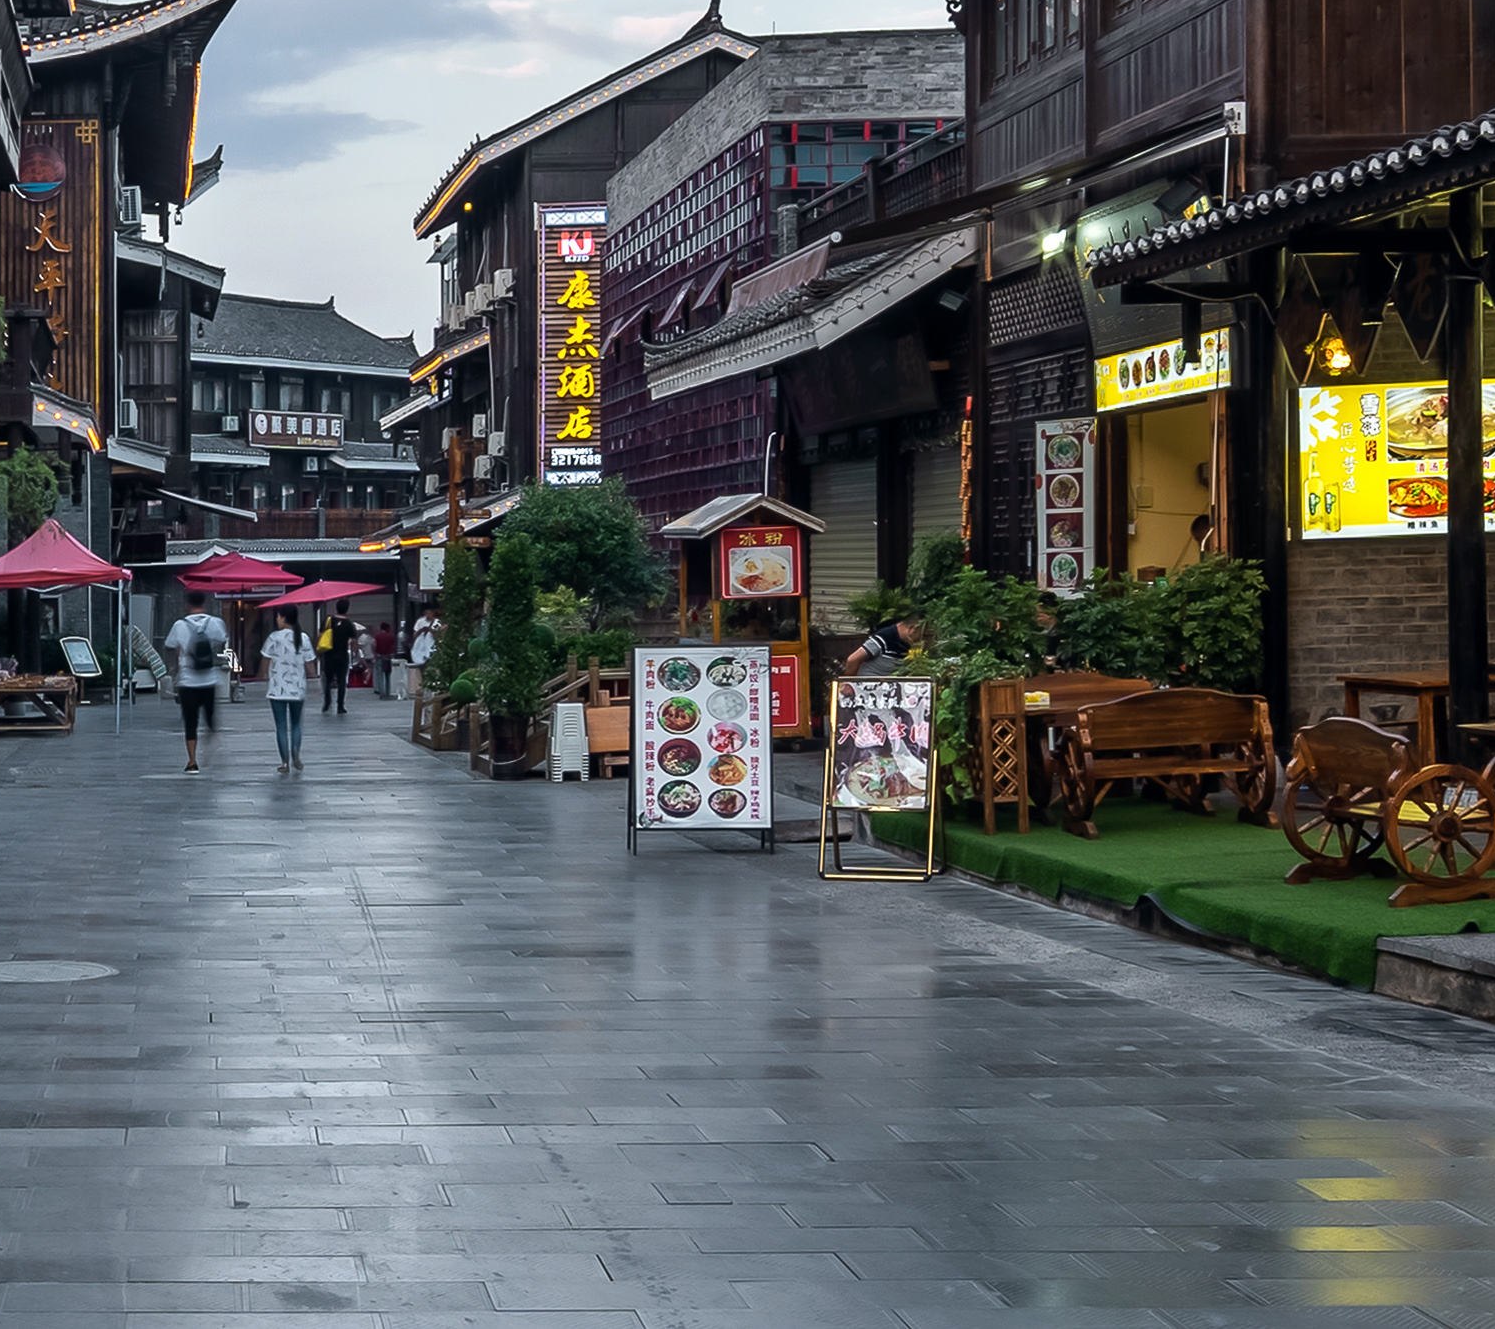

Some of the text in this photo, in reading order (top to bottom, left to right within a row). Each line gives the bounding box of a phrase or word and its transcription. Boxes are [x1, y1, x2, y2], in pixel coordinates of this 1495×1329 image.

[557, 270, 599, 440] 康杰酒店
[1359, 393, 1381, 437] 雪花
[551, 454, 602, 465] 3217688
[1340, 422, 1358, 493] 匠心营造
[739, 532, 783, 546] 冰粉
